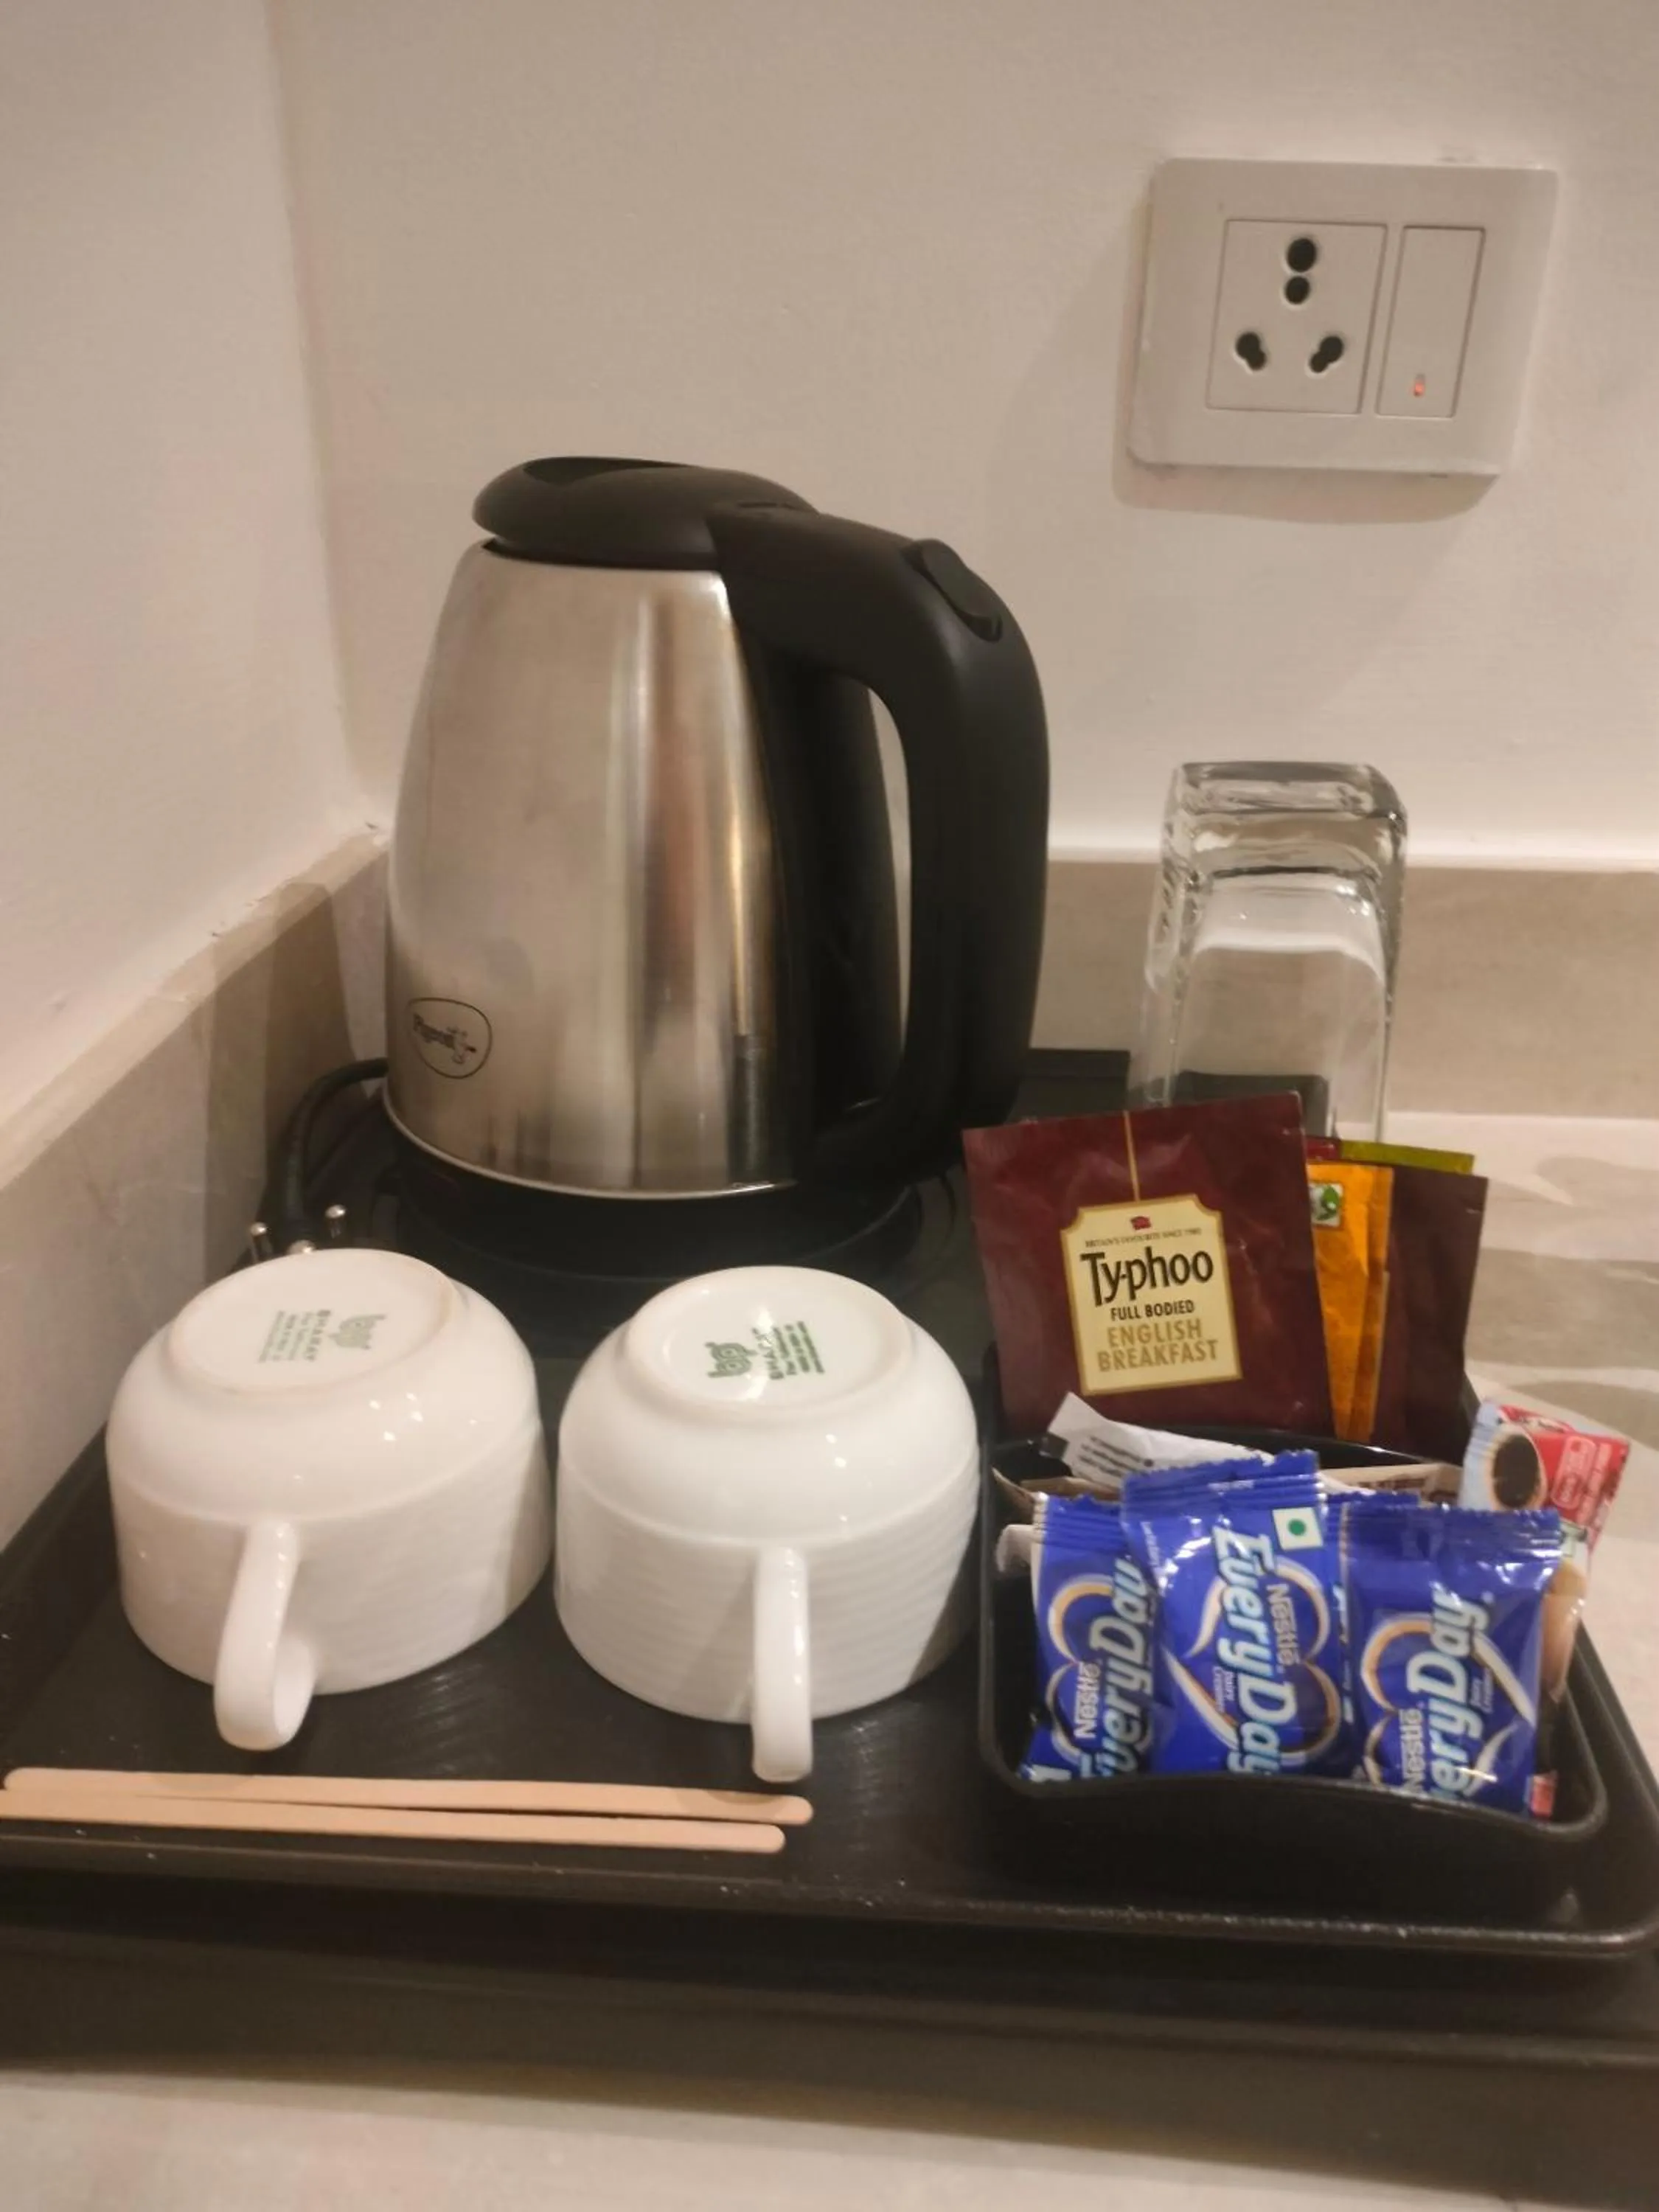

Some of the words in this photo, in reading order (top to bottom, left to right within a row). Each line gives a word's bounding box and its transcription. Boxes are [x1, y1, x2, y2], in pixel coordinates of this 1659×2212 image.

[1110, 1304, 1142, 1321] FULL
[1144, 1299, 1195, 1318] BODIED
[1107, 1318, 1203, 1349] ENGLISH
[1096, 1339, 1219, 1373] BREAKFAST
